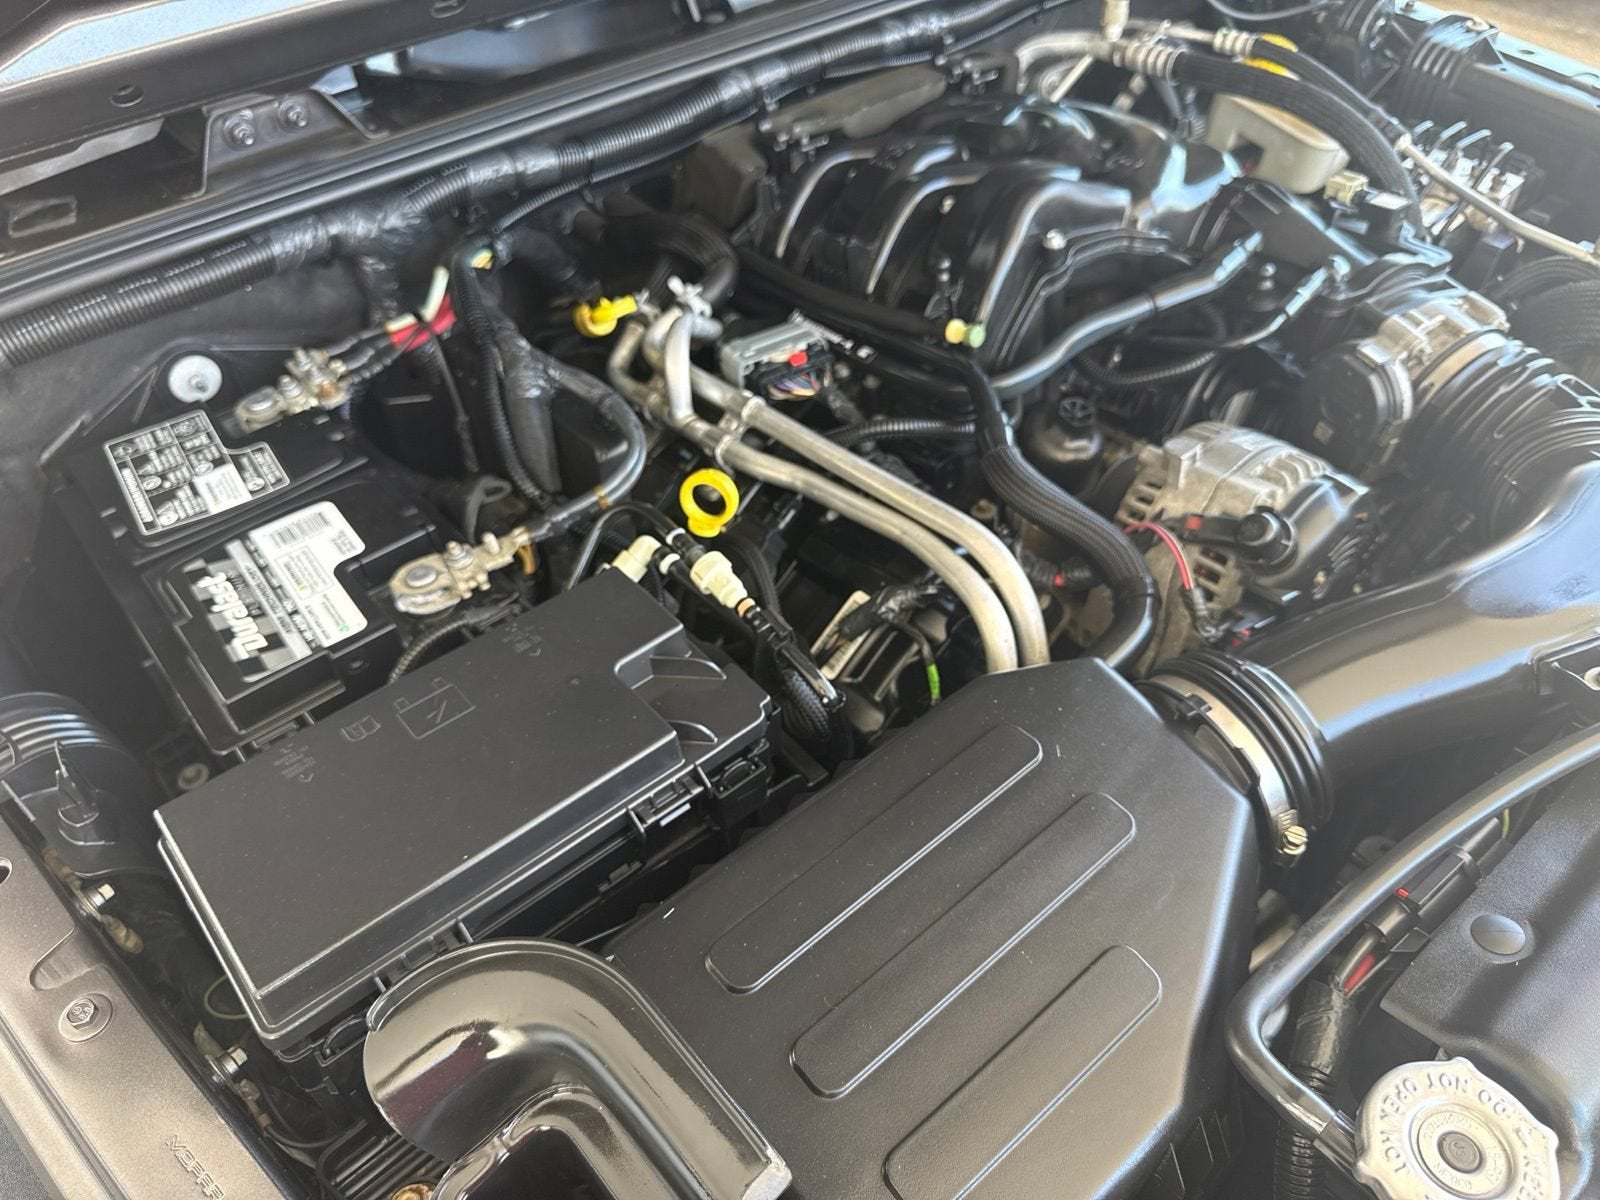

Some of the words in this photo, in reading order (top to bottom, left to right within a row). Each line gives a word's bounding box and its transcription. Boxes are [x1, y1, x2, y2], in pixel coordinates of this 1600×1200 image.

[195, 571, 268, 659] Duralast
[1379, 1077, 1418, 1120] OPEN
[1426, 1072, 1470, 1095] NOT
[165, 1134, 225, 1200] MOPAR
